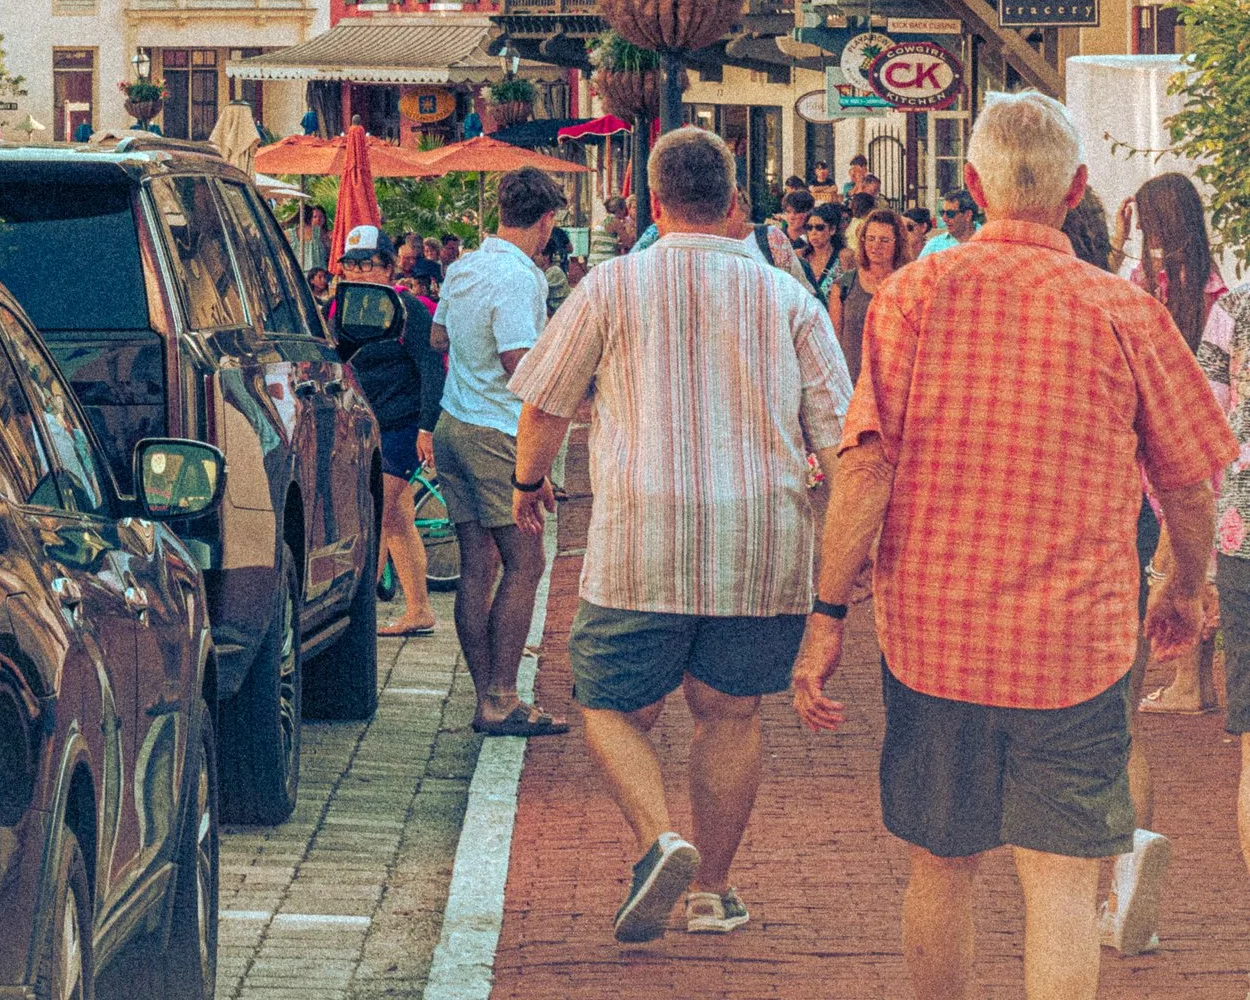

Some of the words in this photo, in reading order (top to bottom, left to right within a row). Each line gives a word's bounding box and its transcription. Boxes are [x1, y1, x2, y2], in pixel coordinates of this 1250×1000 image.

[1005, 6, 1093, 17] tracery
[847, 34, 869, 53] PLAYA
[886, 45, 947, 60] COWGIRL
[885, 62, 942, 89] CK
[886, 92, 946, 106] KITCHEN
